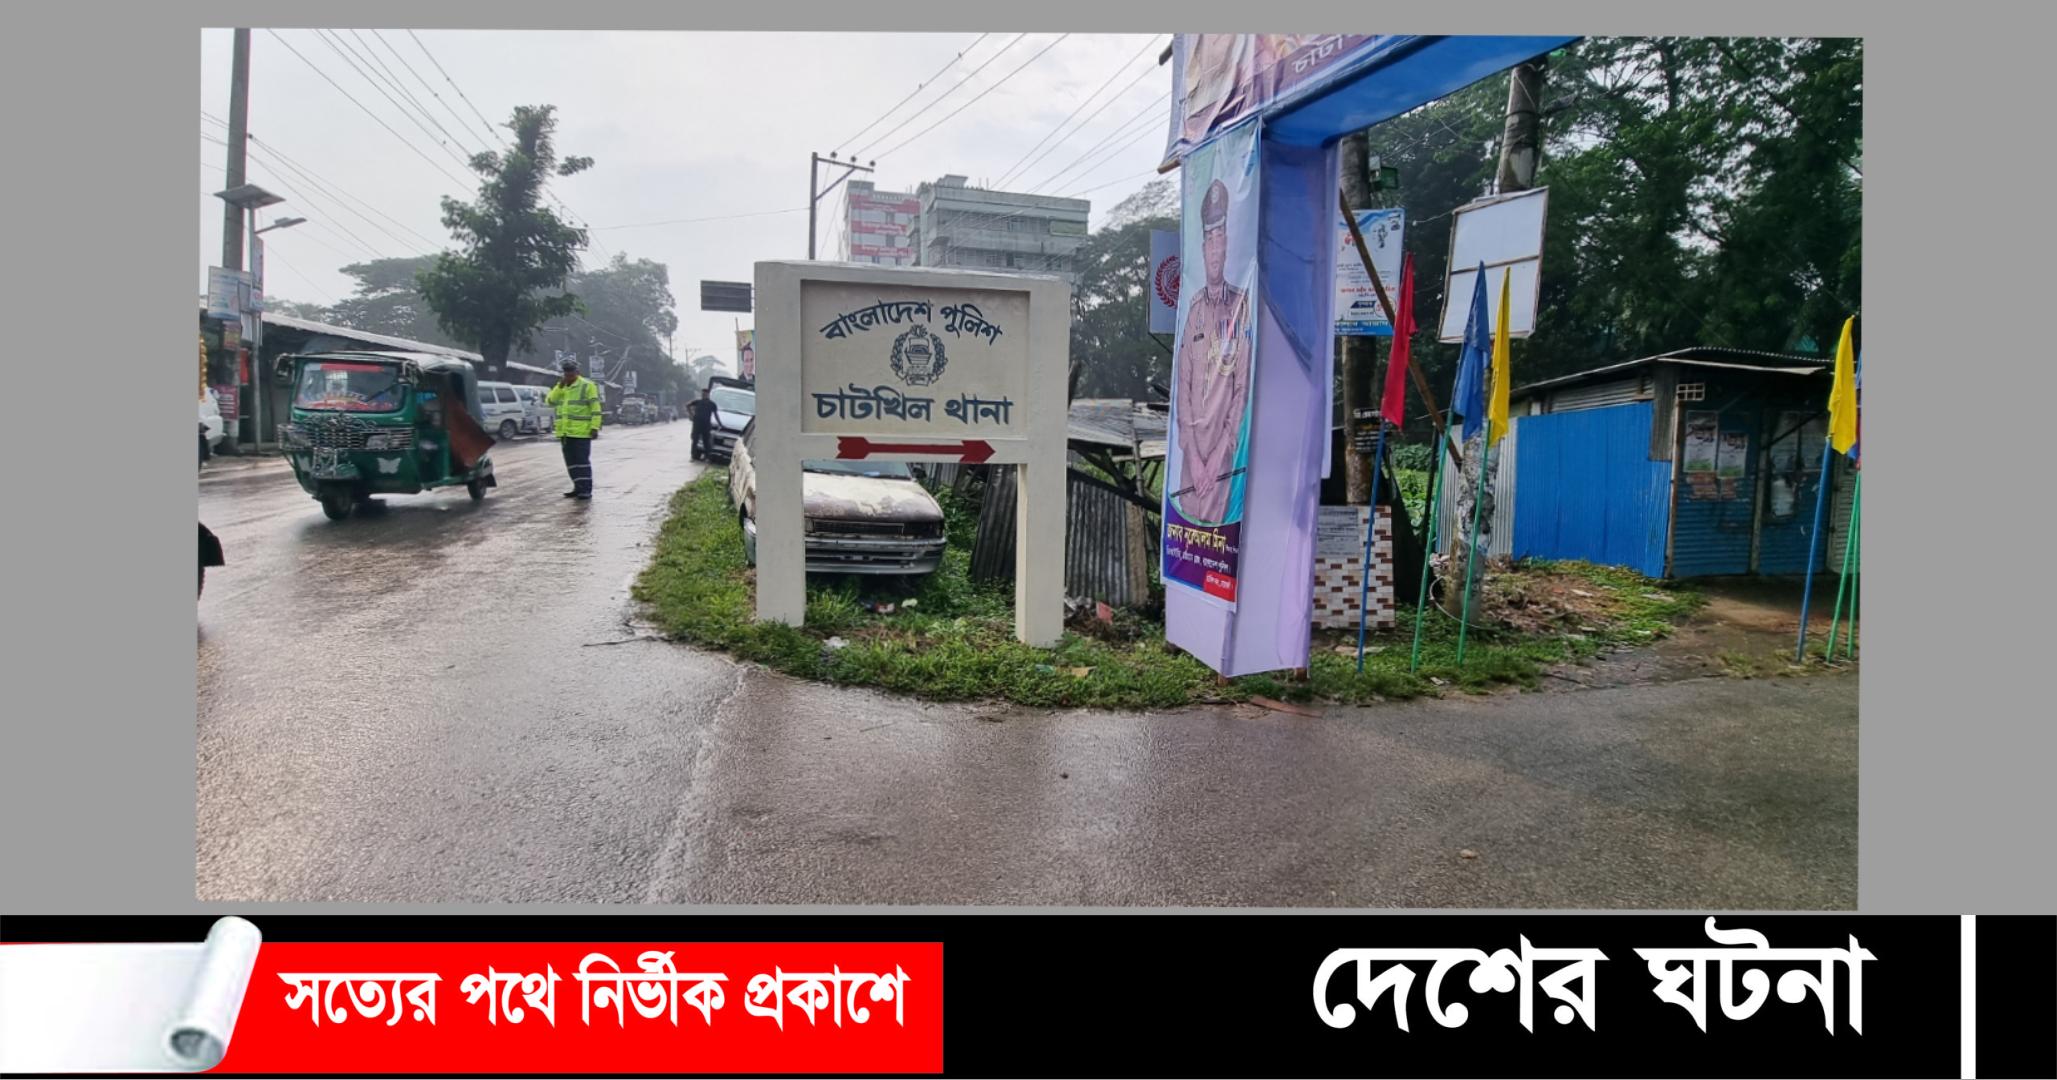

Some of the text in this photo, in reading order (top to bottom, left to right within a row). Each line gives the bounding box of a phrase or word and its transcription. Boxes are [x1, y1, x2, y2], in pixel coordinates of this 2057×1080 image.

[819, 297, 1003, 346] বাংলাদেশ পুলিশ
[811, 383, 1014, 425] চাটখিল থানা
